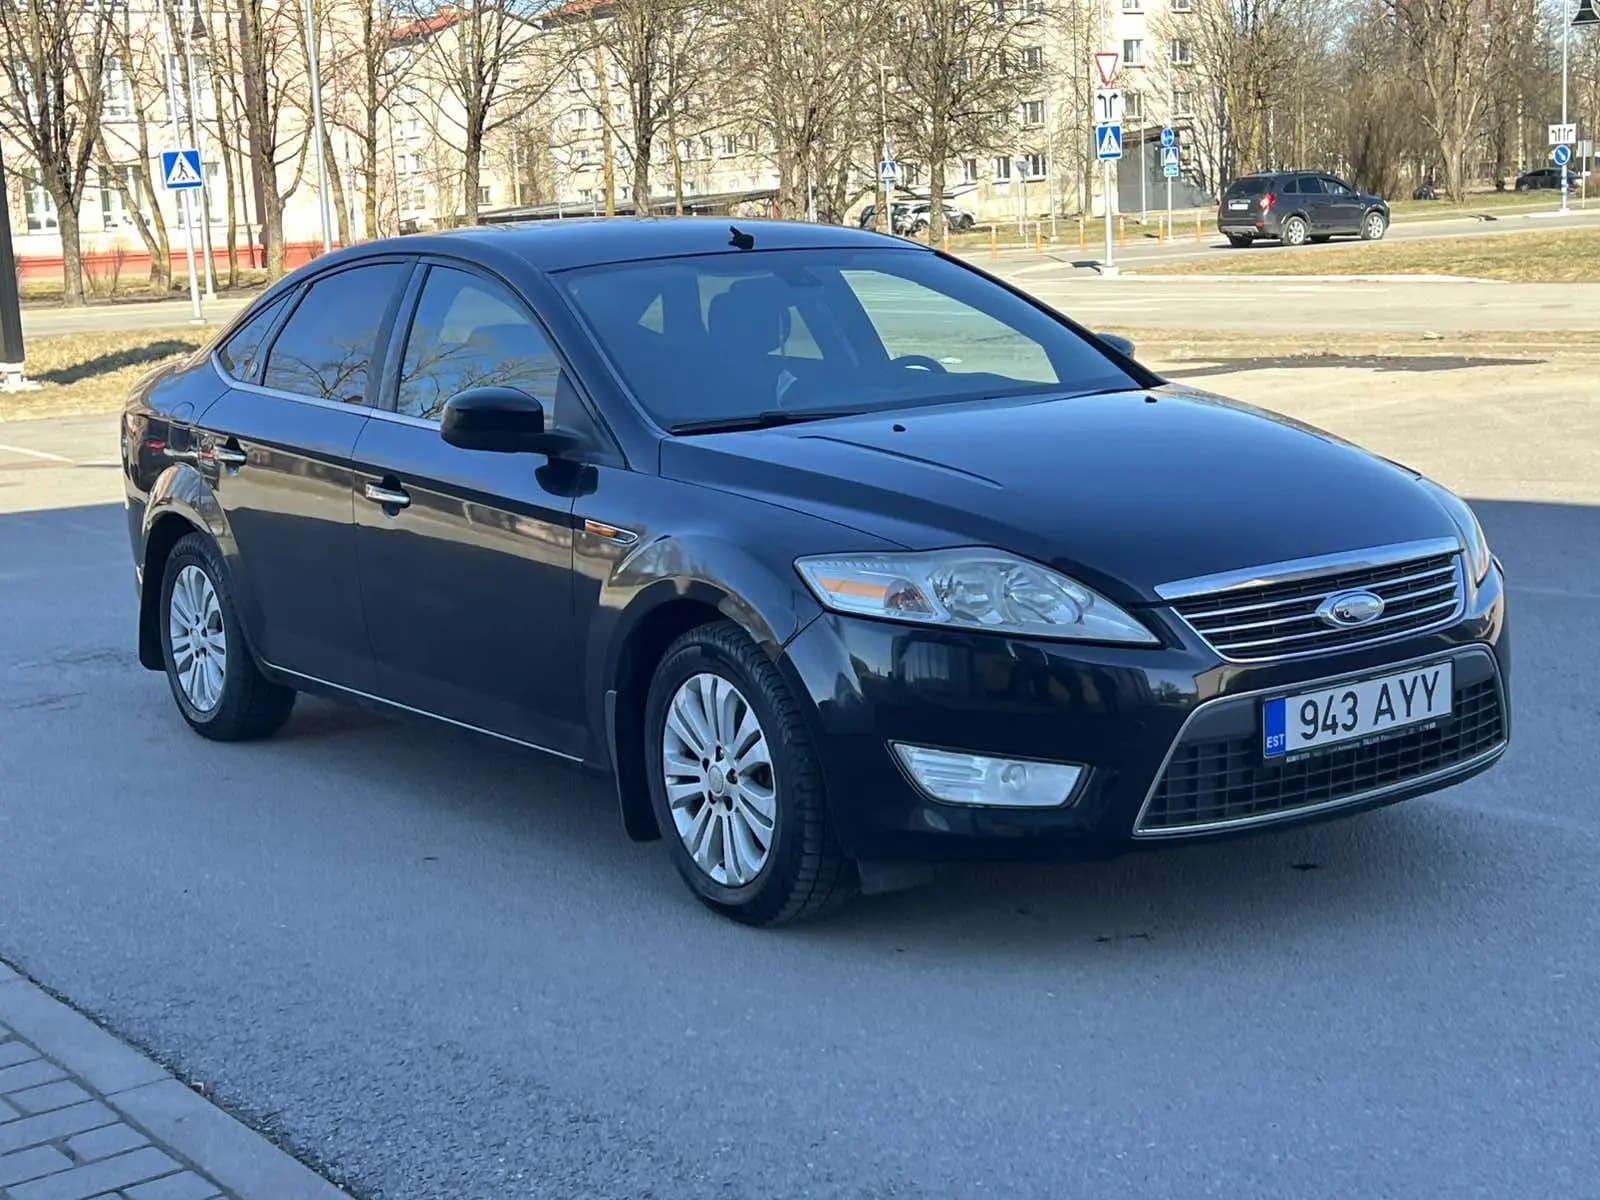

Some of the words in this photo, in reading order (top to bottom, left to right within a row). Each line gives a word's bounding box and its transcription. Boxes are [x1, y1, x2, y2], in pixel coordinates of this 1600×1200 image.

[1300, 692, 1358, 740] 943
[1373, 671, 1440, 726] AYY
[1266, 733, 1285, 749] EST
